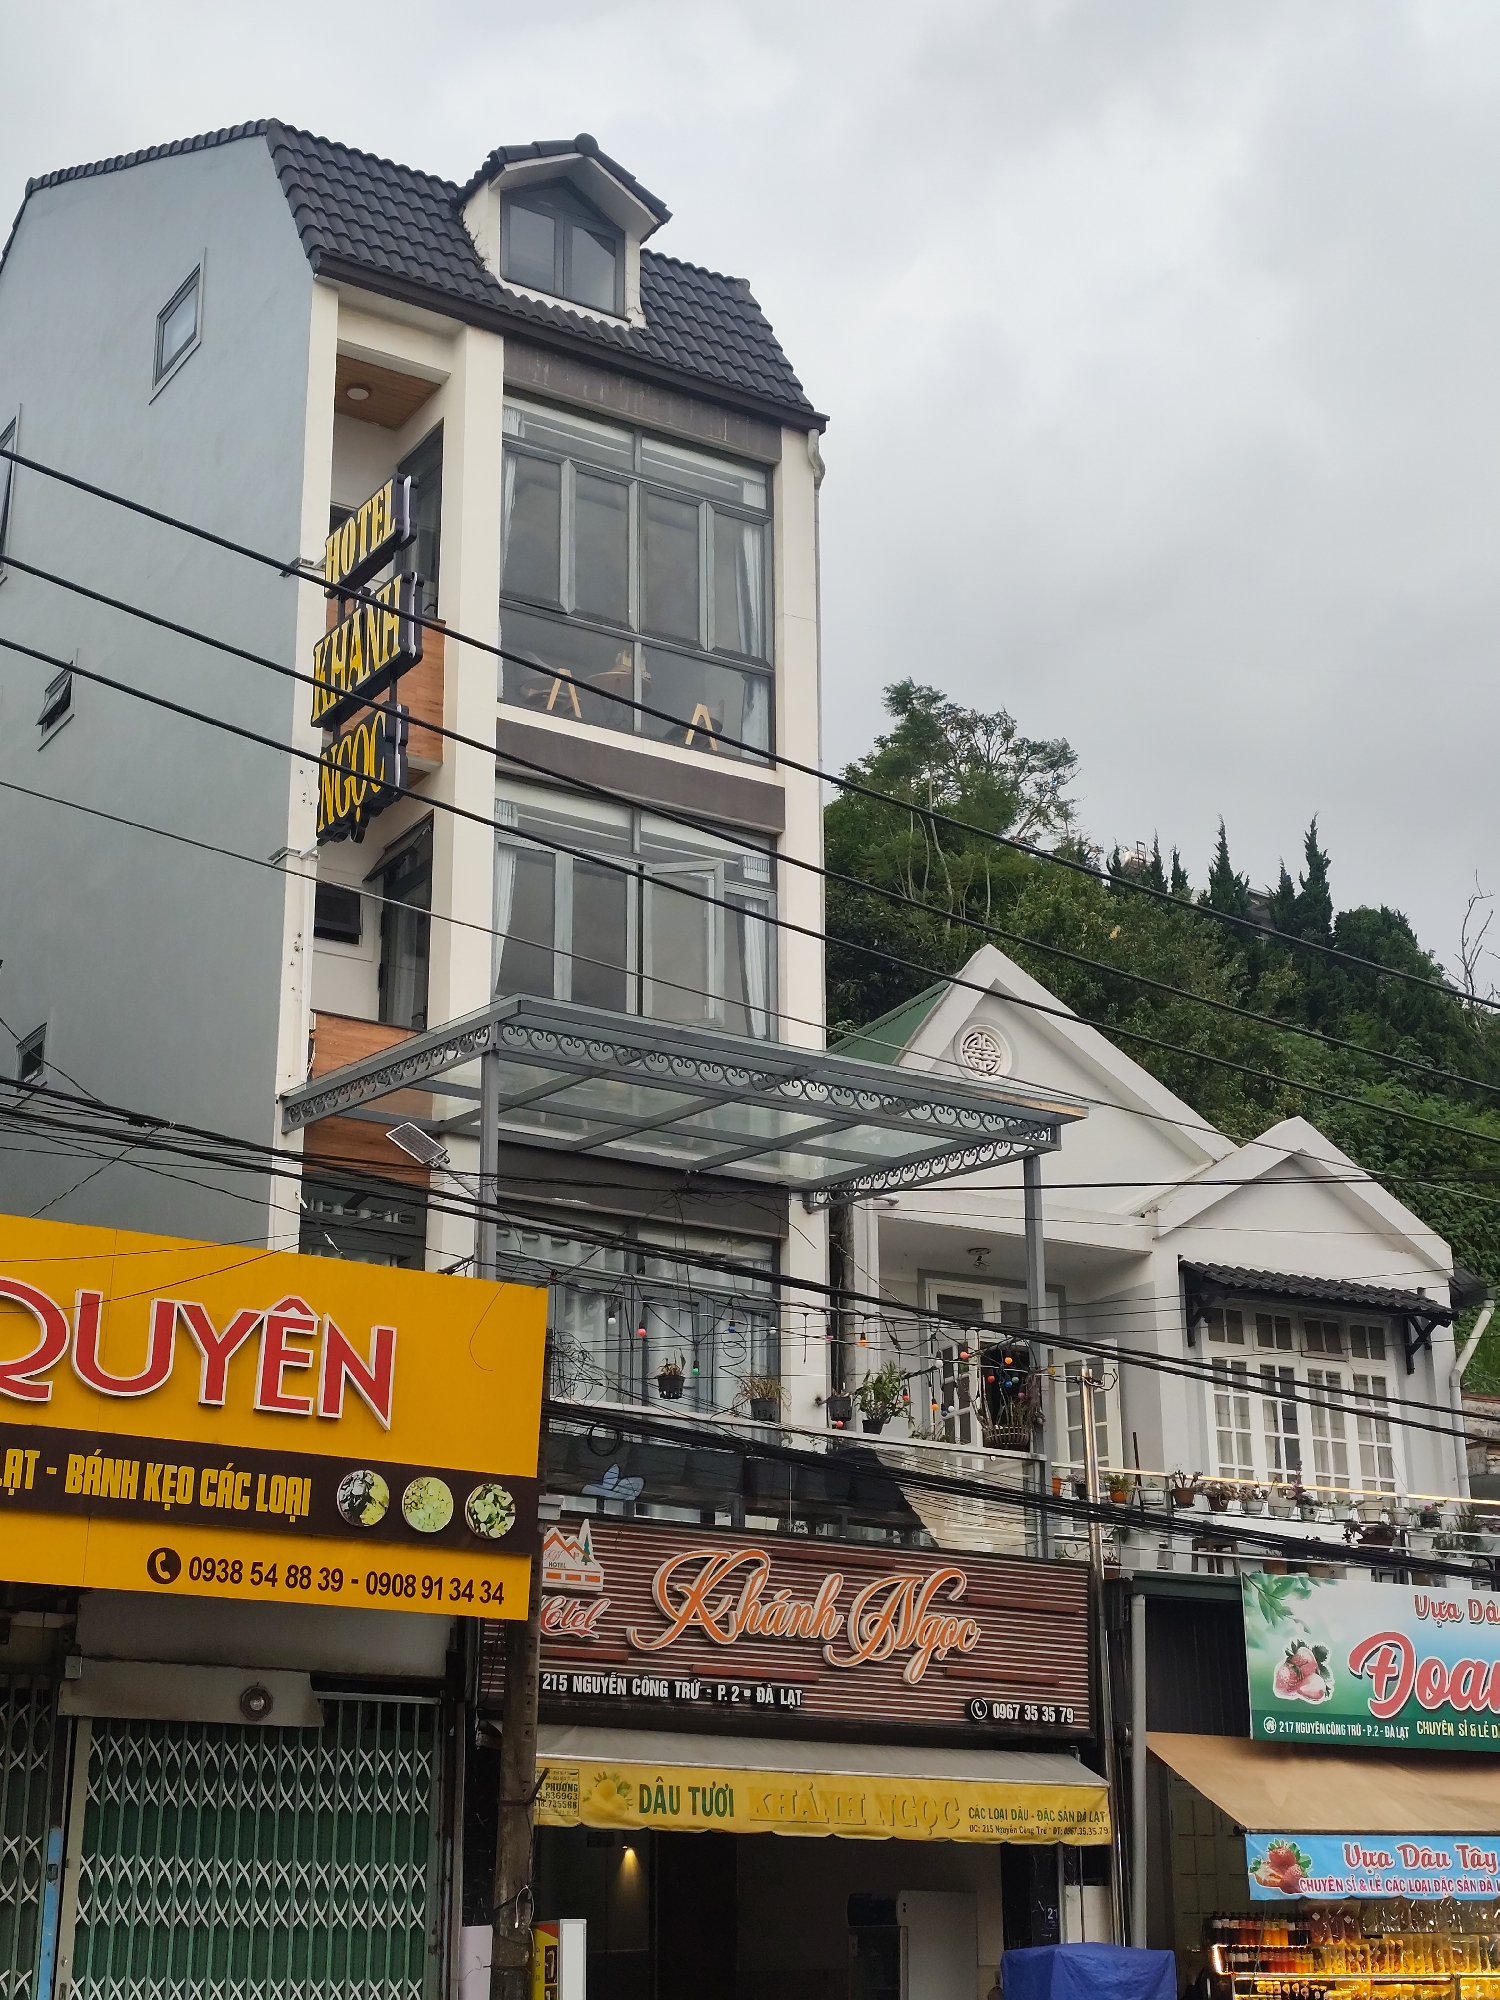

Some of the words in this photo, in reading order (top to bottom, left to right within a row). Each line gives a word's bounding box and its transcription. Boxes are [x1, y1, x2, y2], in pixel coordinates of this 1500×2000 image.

[325, 479, 397, 590] HOTEL
[312, 574, 402, 723] KHÁNH
[317, 711, 387, 832] NGỌC
[0, 1276, 397, 1430] QUYÊN
[0, 1449, 40, 1495] ẠT
[65, 1449, 140, 1500] BÁNH
[143, 1462, 195, 1511] KẸO
[200, 1463, 251, 1510] CÁC
[256, 1474, 312, 1523] LOẠI
[188, 1556, 243, 1584] 0938
[250, 1561, 278, 1588] 54
[285, 1565, 312, 1590] 88
[317, 1567, 344, 1592] 39
[365, 1571, 416, 1599] 0908
[421, 1575, 444, 1600] 91
[449, 1578, 474, 1603] 34
[479, 1580, 504, 1605] 34
[626, 1549, 845, 1650] Khánh
[823, 1568, 981, 1685] Ngọc
[1414, 1594, 1465, 1628] Vựa
[542, 1673, 568, 1691] 215
[573, 1672, 627, 1695] NGUYỄN
[632, 1676, 668, 1698] CÔNG
[674, 1679, 701, 1699] TRỨ
[756, 1683, 774, 1704] ĐÀ
[780, 1689, 803, 1709] LẠT
[1348, 1631, 1500, 1718] Đoa
[992, 1703, 1020, 1720] 0967
[1024, 1705, 1039, 1721] 35
[1041, 1706, 1056, 1722] 35
[1060, 1707, 1074, 1723] 79
[1280, 1721, 1294, 1733] 217
[1326, 1721, 1346, 1736] CÔNG
[1416, 1720, 1454, 1737] CHUYÊN
[1469, 1724, 1477, 1737] &
[1478, 1720, 1490, 1738] LẺ
[545, 1781, 578, 1792] PHƯƠNG
[638, 1776, 681, 1815] DÂU
[688, 1781, 735, 1817] TƯƠI
[747, 1782, 866, 1825] KHÁNH
[873, 1794, 961, 1836] NGỌC
[968, 1804, 986, 1819] CÁC
[988, 1807, 1008, 1823] LOẠI
[1011, 1805, 1029, 1820] DÂU
[1036, 1807, 1055, 1825] ĐẶC
[1057, 1805, 1075, 1822] SẢN
[1077, 1807, 1087, 1822] ĐÀ
[1089, 1811, 1106, 1826] LẠT
[982, 1825, 994, 1833] 215
[1343, 1843, 1394, 1874] Vựa
[1396, 1844, 1451, 1869] Dâu
[1454, 1844, 1499, 1875] Tây
[1300, 1876, 1344, 1892] CHUYÊN
[1359, 1879, 1367, 1892] &
[1369, 1874, 1381, 1892] LẺ
[1385, 1876, 1406, 1892] CÁC
[1408, 1879, 1432, 1895] LOẠI
[1433, 1876, 1454, 1896] ĐẶC
[1456, 1874, 1477, 1892] SẢN
[1480, 1876, 1494, 1892] ĐÀ
